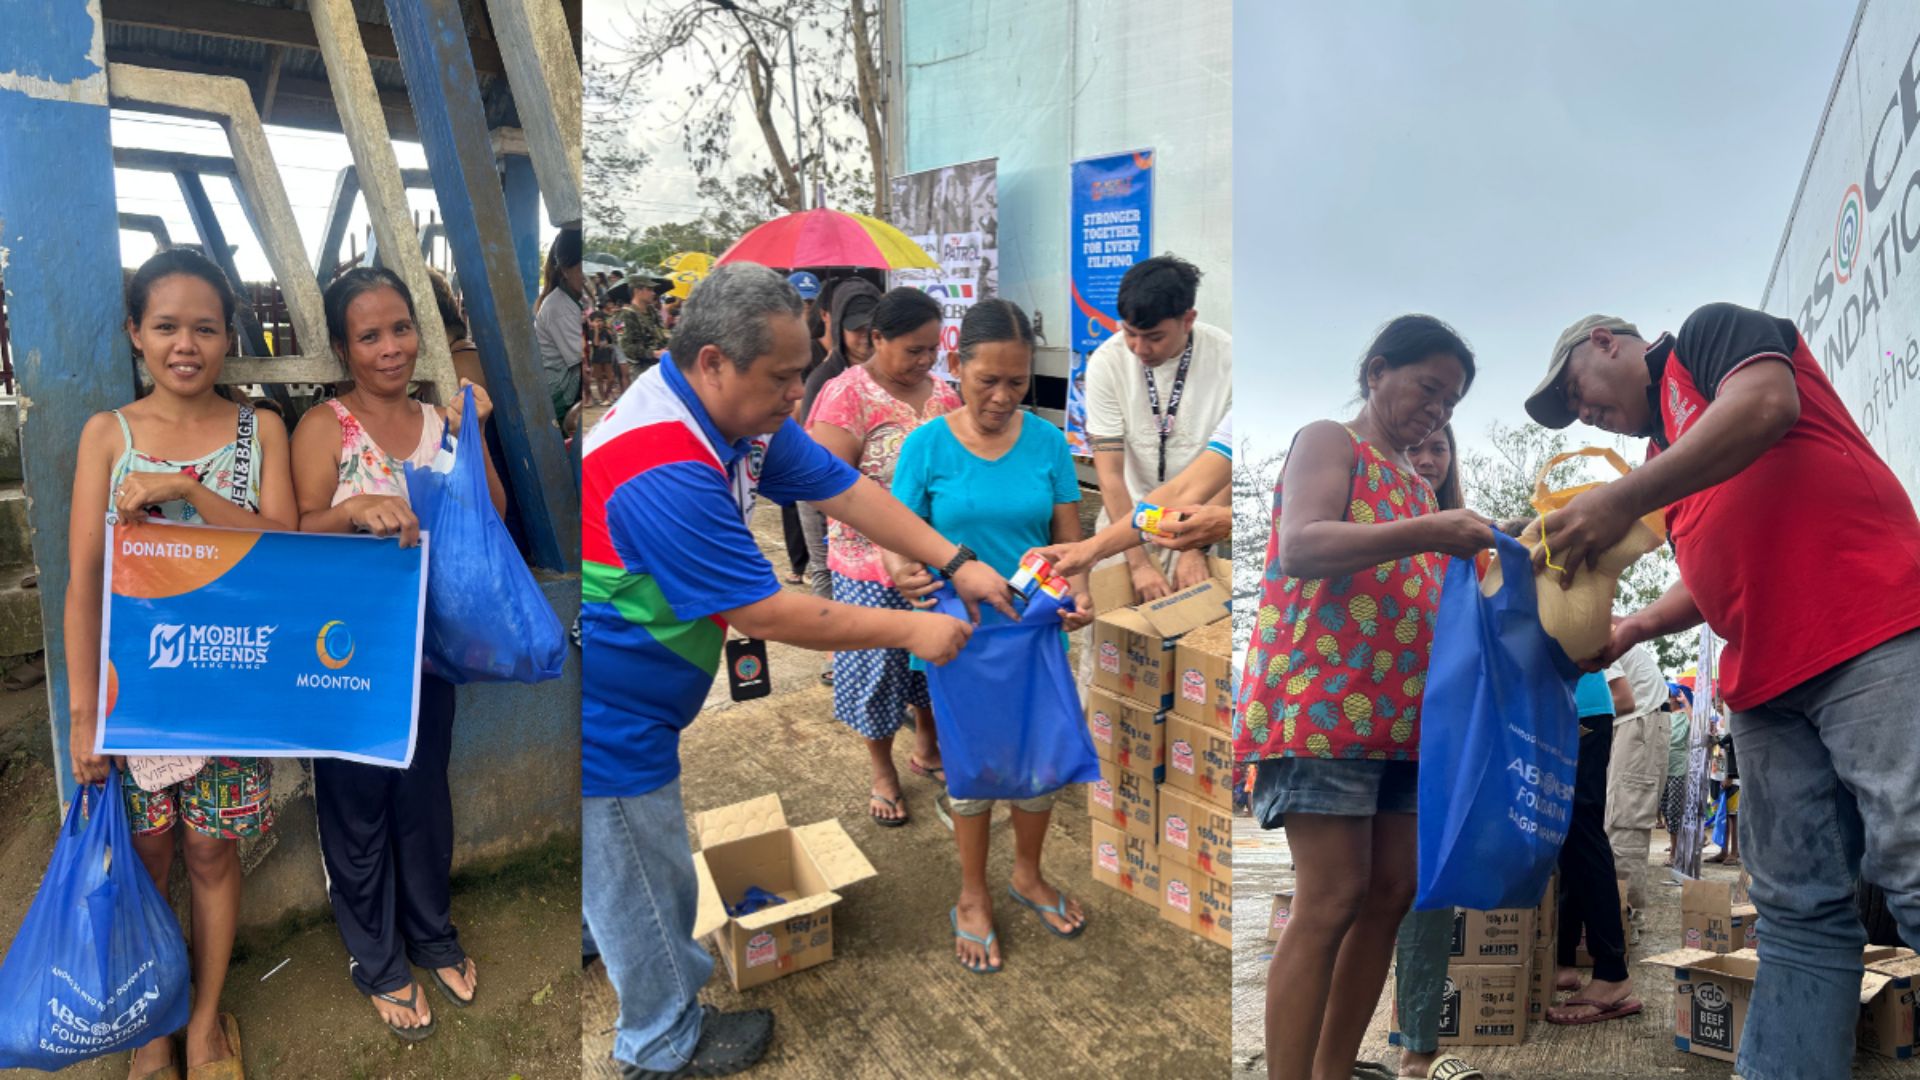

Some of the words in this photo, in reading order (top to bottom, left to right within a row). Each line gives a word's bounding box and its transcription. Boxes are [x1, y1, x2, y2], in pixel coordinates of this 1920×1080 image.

[1083, 209, 1141, 226] STRONGER
[945, 244, 981, 261] PATROL
[1083, 241, 1103, 255] FOR
[1104, 239, 1140, 253] EVERY
[1797, 247, 1834, 346] BS
[1863, 376, 1880, 436] of
[1884, 338, 1919, 409] the
[122, 540, 192, 558] DONATED
[195, 545, 219, 559] BY:
[189, 624, 279, 647] MOBILE
[187, 645, 269, 664] LEGENDS
[296, 673, 371, 692] MOONTON
[1700, 989, 1723, 1002] cdo
[1700, 1011, 1724, 1026] BEEF
[51, 1014, 146, 1045] FOUNDATION
[1700, 1024, 1725, 1040] LOAF
